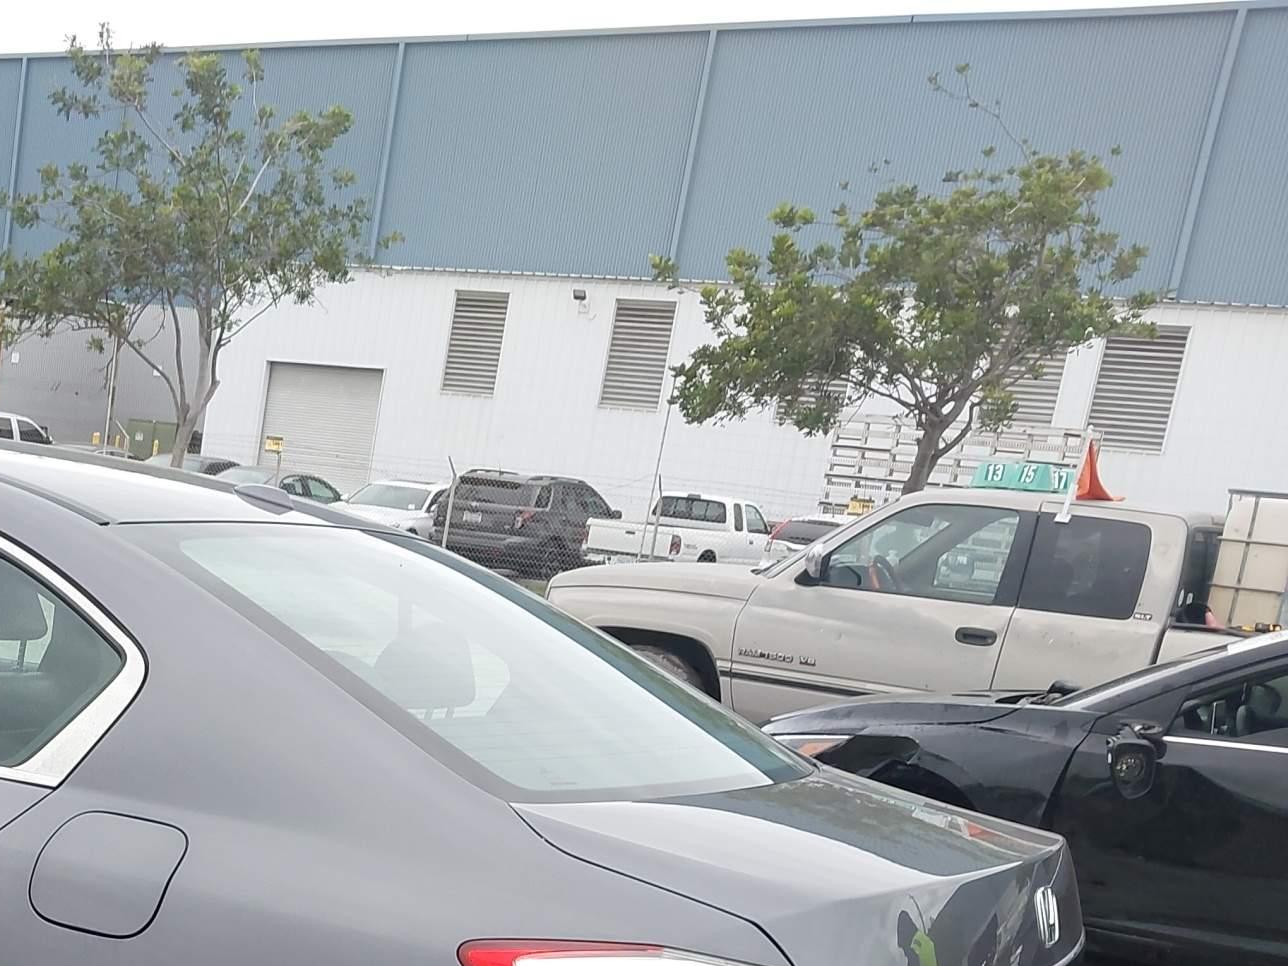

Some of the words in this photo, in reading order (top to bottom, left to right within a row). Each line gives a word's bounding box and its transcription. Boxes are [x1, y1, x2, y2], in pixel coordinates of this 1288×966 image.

[986, 464, 1005, 482] 13
[1019, 464, 1038, 484] 15
[1053, 471, 1068, 490] 17
